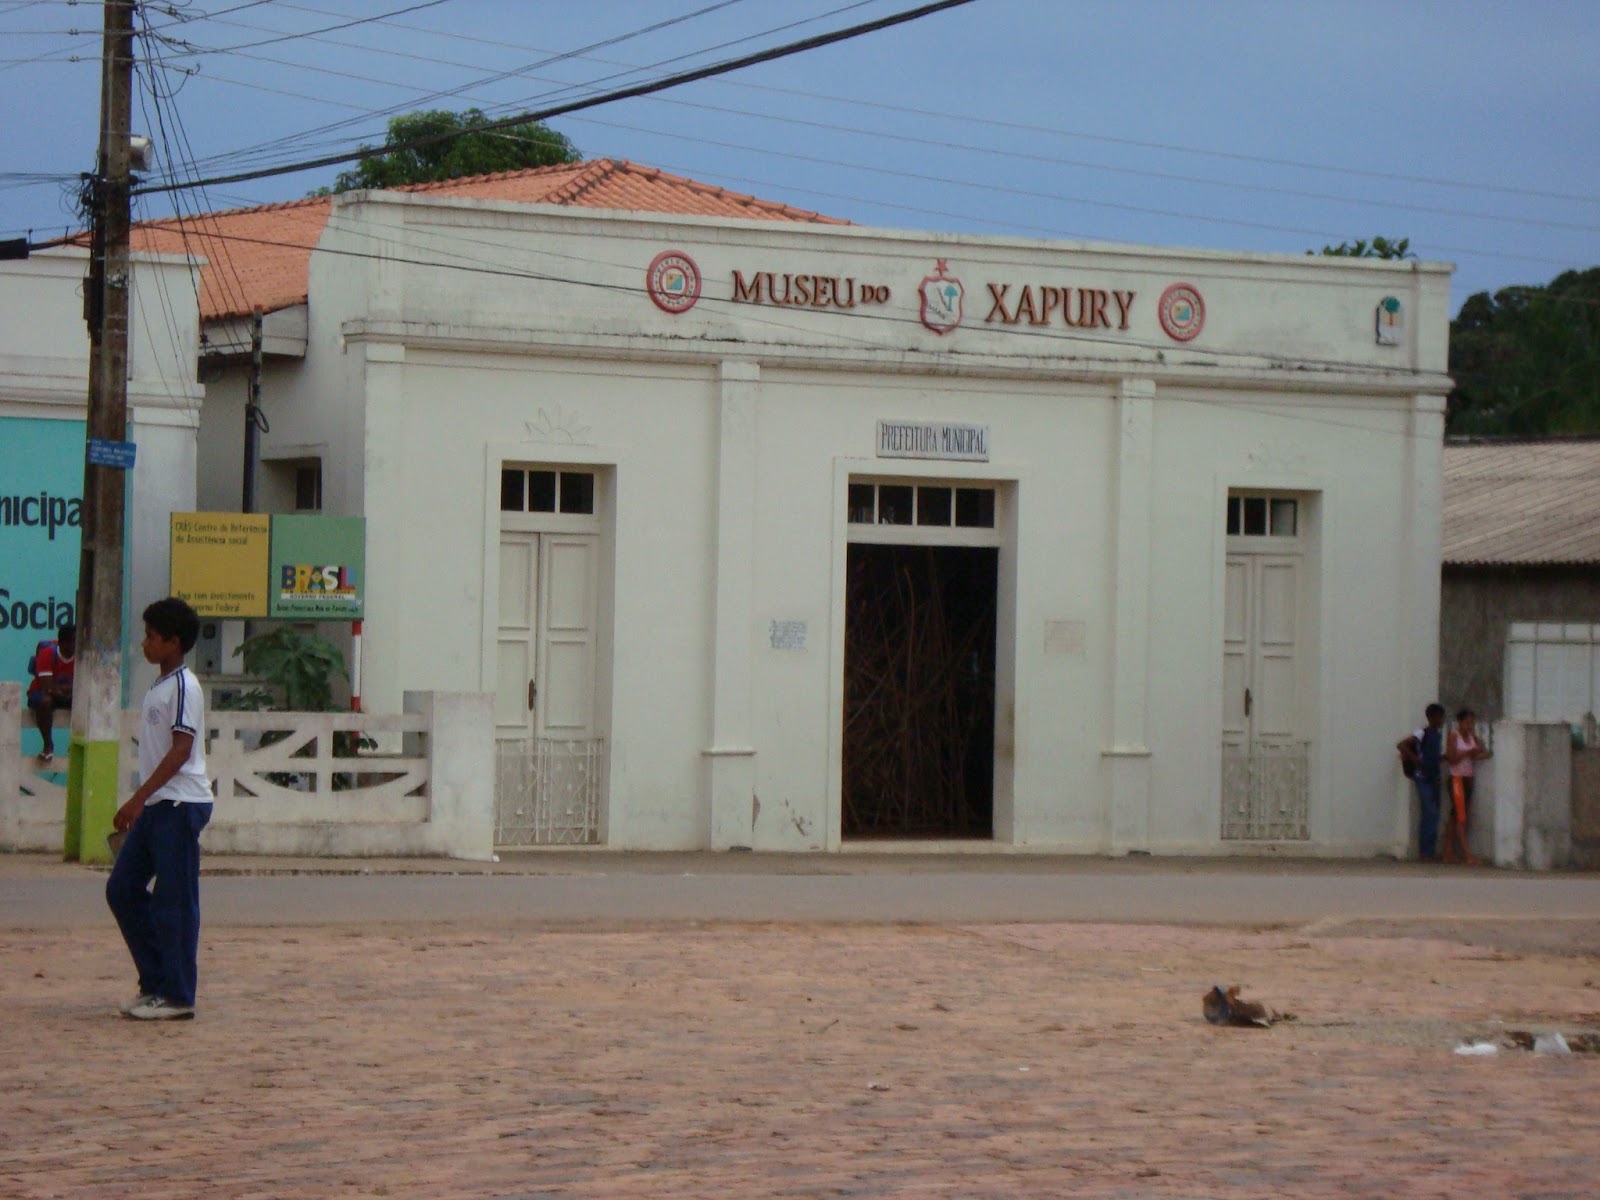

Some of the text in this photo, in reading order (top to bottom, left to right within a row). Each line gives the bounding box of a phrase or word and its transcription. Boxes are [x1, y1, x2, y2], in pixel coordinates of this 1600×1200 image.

[731, 270, 856, 308] MUSEU
[861, 284, 891, 304] DO
[985, 283, 1136, 330] XAPURY
[881, 423, 987, 455] PREFEITURA MUNICIPAL
